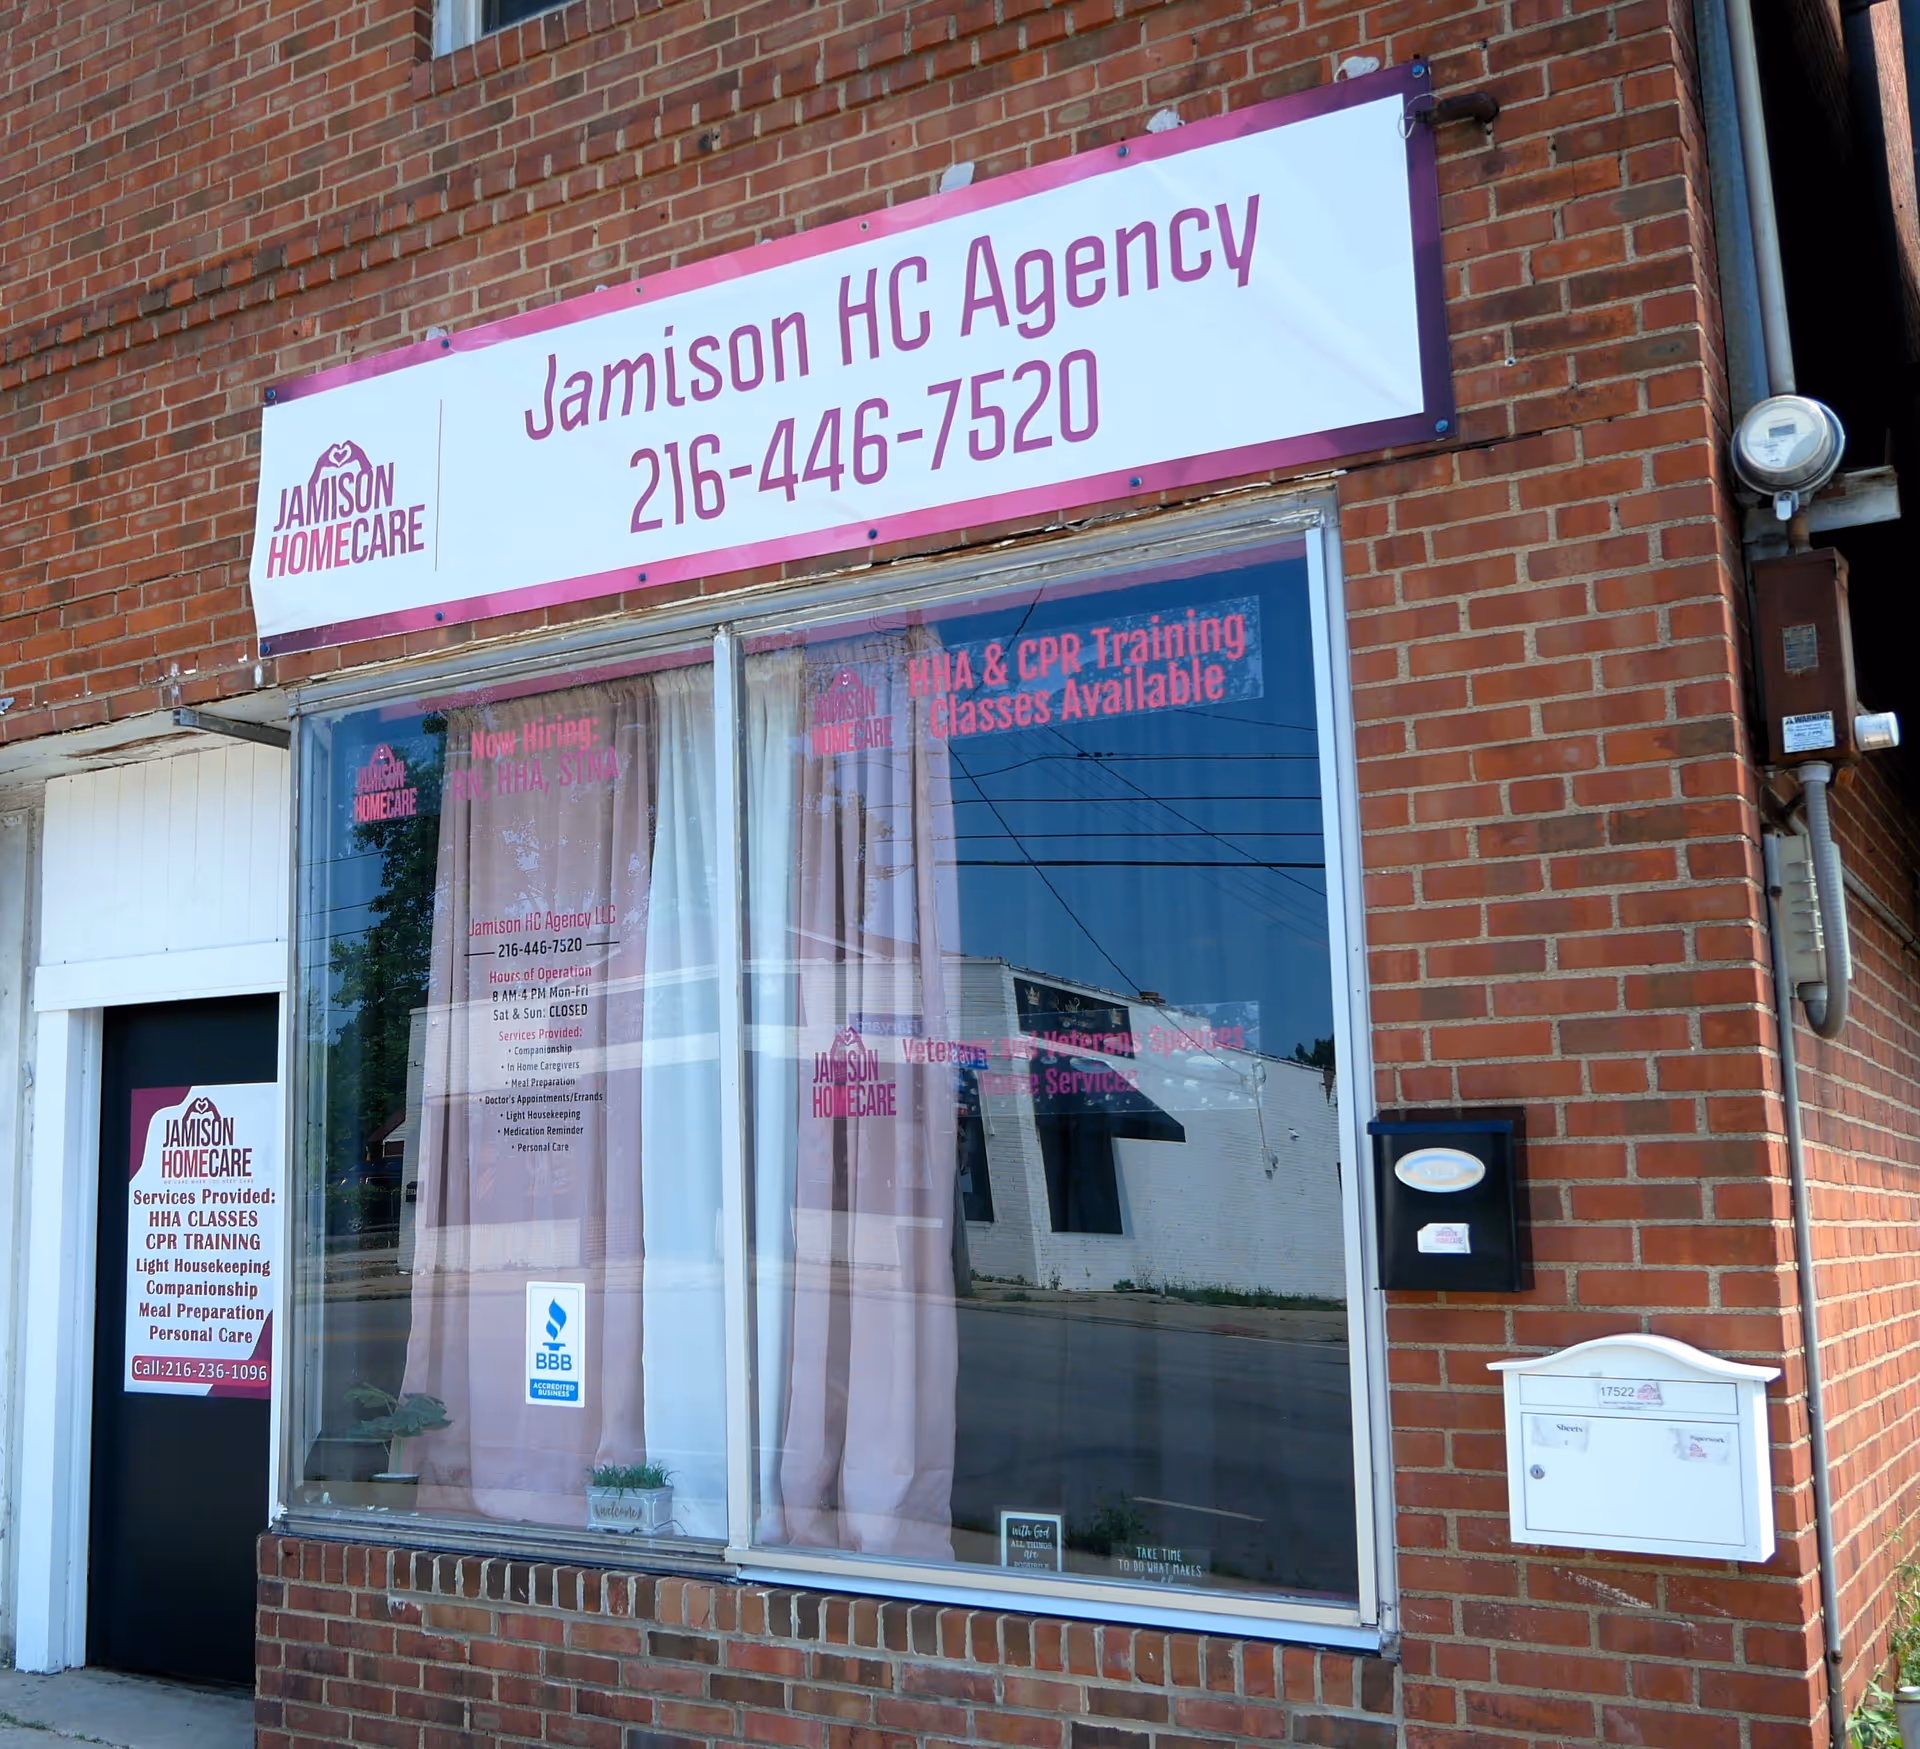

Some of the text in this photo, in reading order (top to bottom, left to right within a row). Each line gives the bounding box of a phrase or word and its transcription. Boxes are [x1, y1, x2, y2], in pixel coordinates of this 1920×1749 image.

[524, 194, 1260, 441] Jamison HC Agency
[629, 348, 1098, 534] 216-446-7520
[273, 462, 395, 532] JAMISON
[266, 504, 425, 579] HOMECARE
[908, 608, 1247, 696] HHA & CPR Training
[929, 660, 1225, 739] Classes Available
[471, 714, 599, 760] Now Hiring:
[452, 745, 619, 805] RN, HHA, STNA
[354, 787, 418, 823] HOMECARE
[468, 904, 616, 937] Jamison HC Agency LLC
[498, 937, 582, 958] 216-446-7520
[489, 964, 592, 984] Hours of Operation
[492, 990, 499, 1002] 8
[531, 987, 546, 1000] PM
[549, 984, 589, 1000] Mon-Fri
[493, 1004, 588, 1021] Sat & Sun: CLOSED
[498, 1027, 583, 1042] Services Provided:
[1043, 1029, 1143, 1058] Veterans
[1148, 1025, 1245, 1059] Spouses
[514, 1043, 572, 1056] Companionship
[507, 1060, 580, 1072] In Home Caregivers
[511, 1077, 576, 1088] Meal Preparation
[1045, 1066, 1139, 1095] Services
[485, 1092, 603, 1105] Doctor's Appointments/Errands
[506, 1109, 581, 1121] Light Housekeeping
[162, 1117, 235, 1147] JAMISON
[503, 1125, 584, 1137] Medication Reminder
[517, 1142, 569, 1152] Personal Care
[161, 1147, 252, 1178] HOMECARE
[133, 1188, 276, 1206] Services Provided:
[149, 1210, 258, 1228] HHA CLASSES
[145, 1233, 261, 1251] CPR TRAINING
[136, 1257, 271, 1277] Light Housekeeping
[146, 1279, 258, 1300] Companionship
[139, 1302, 265, 1322] Meal Preparation
[149, 1325, 253, 1344] Personal Care
[133, 1358, 267, 1381] Call:216-236-1096
[535, 1352, 572, 1371] BBB
[532, 1382, 575, 1392] ACCREDITED
[537, 1389, 570, 1398] BUSINESS
[1601, 1386, 1635, 1397] 17522
[1556, 1424, 1583, 1433] Sheets
[1012, 1524, 1050, 1539] with God
[1011, 1540, 1053, 1549] ALL THINGS
[1136, 1546, 1182, 1562] TAKE TIME
[1118, 1559, 1202, 1577] TO DO WHAT MAKES
